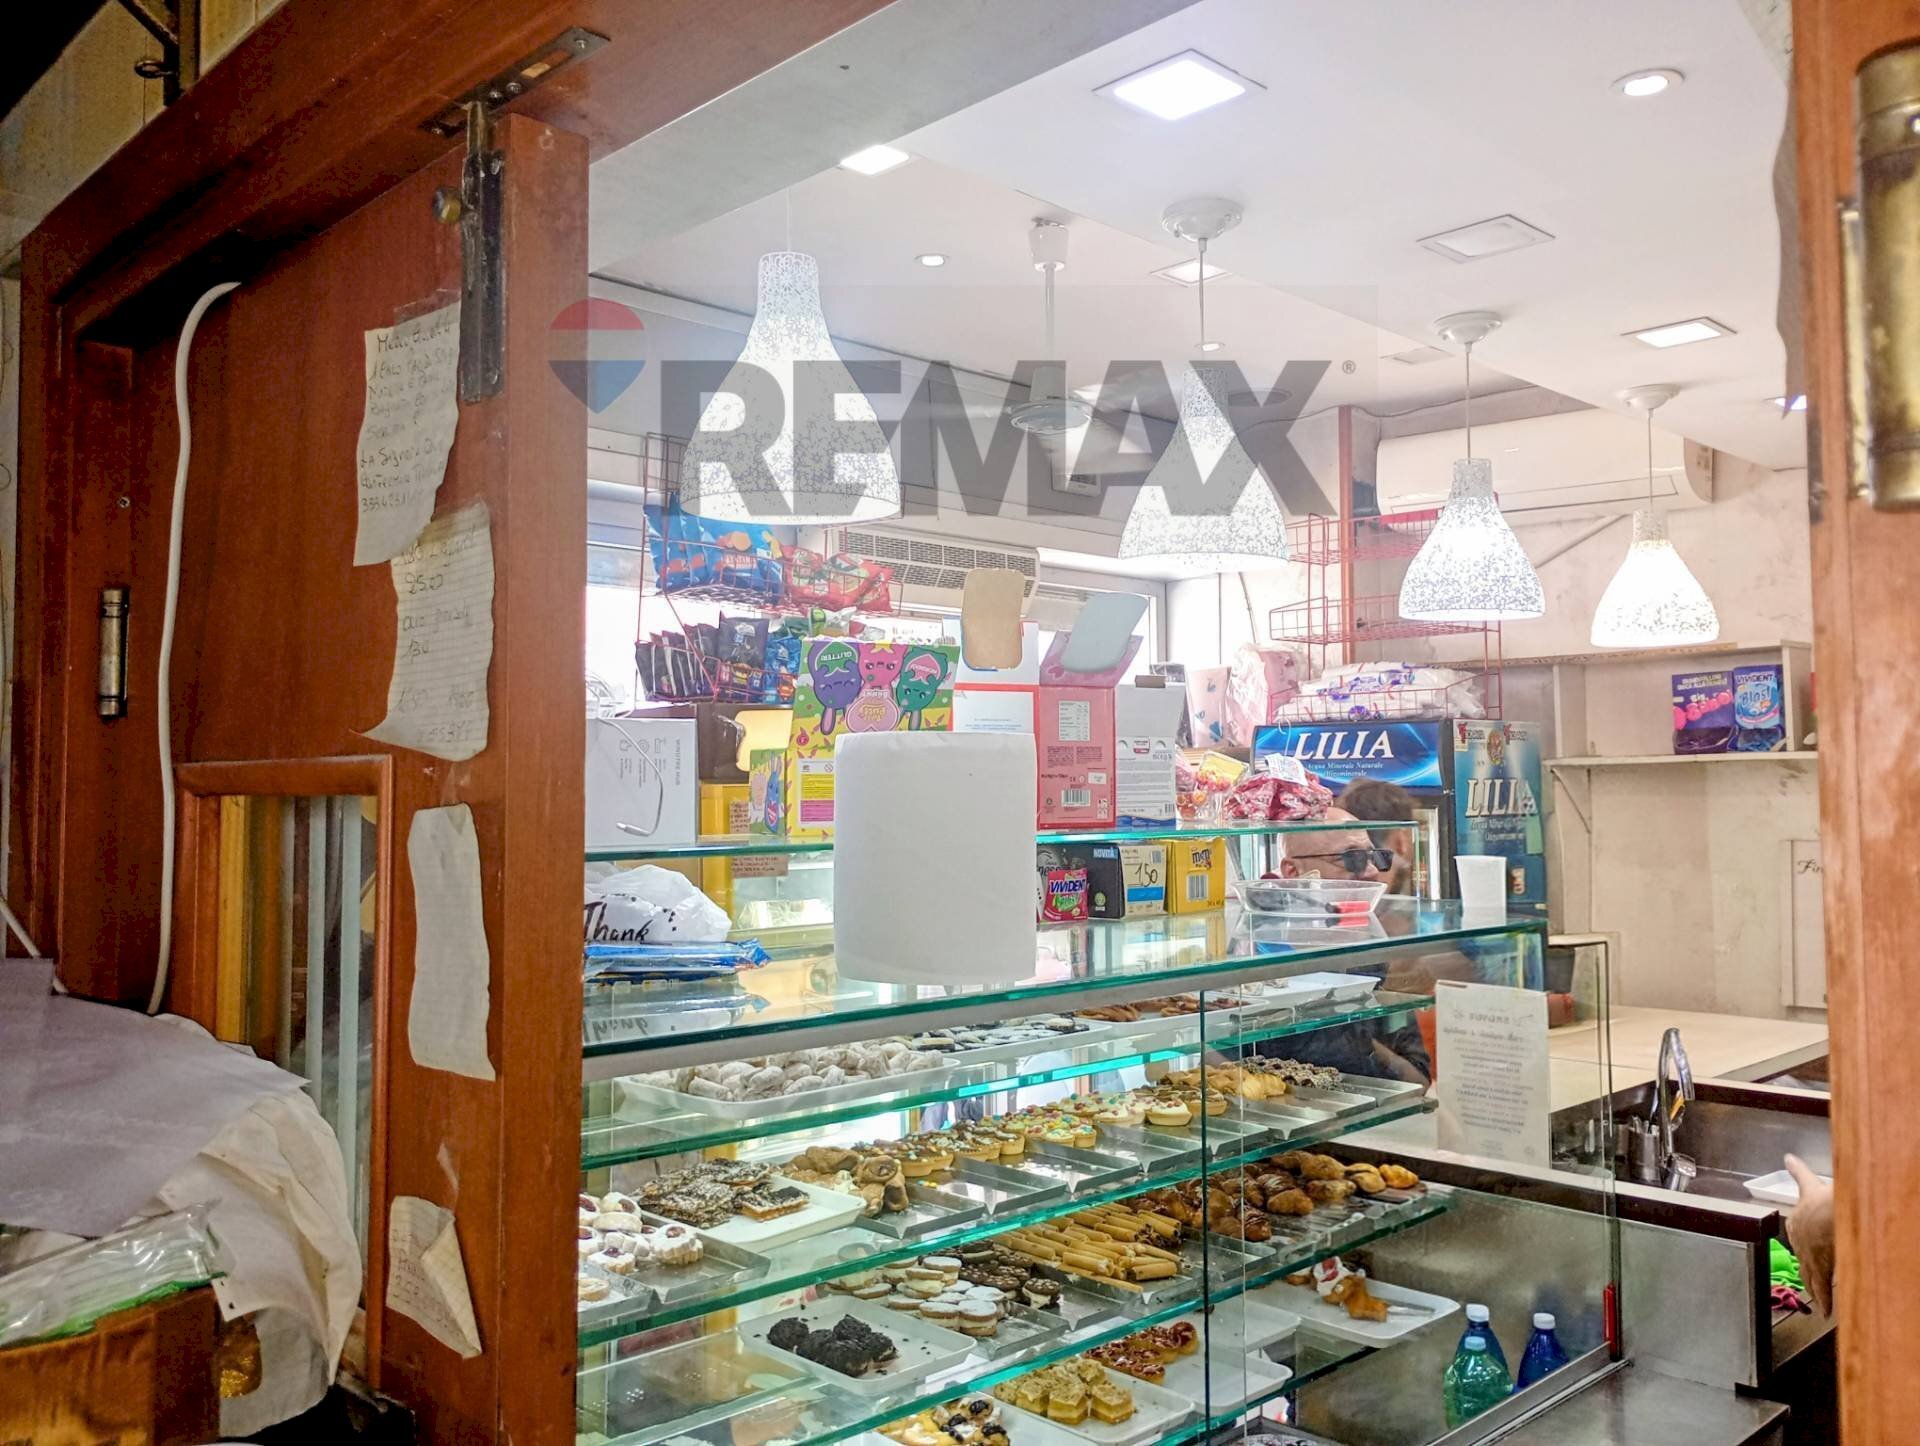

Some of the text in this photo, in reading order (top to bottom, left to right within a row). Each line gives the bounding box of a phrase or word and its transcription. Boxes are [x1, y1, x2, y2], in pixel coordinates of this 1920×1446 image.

[1294, 730, 1394, 760] LILIA
[1465, 778, 1538, 818] LILIA
[584, 901, 654, 942] Thank
